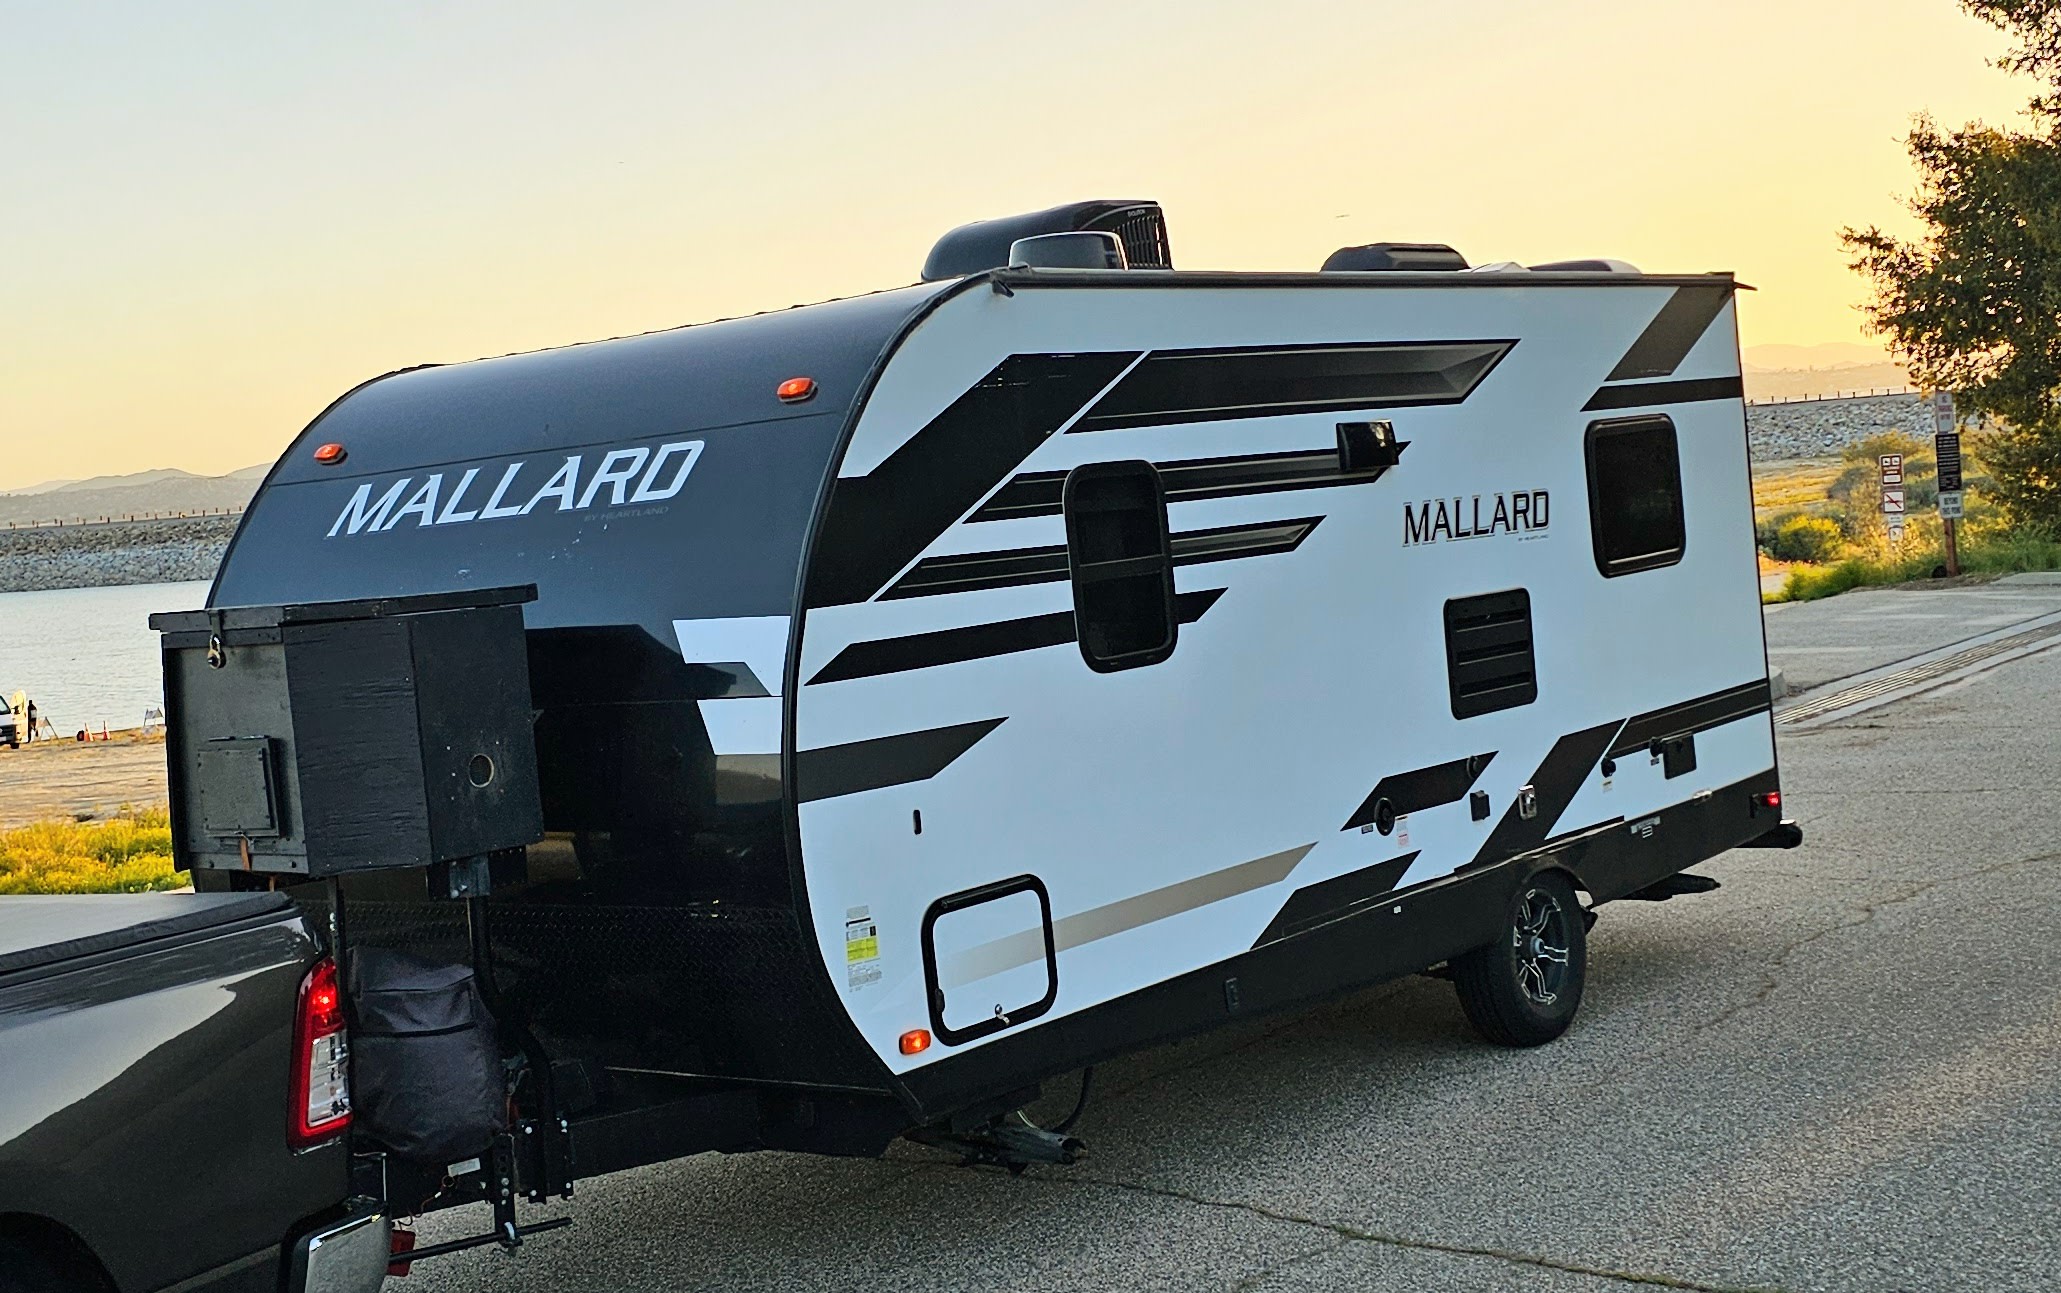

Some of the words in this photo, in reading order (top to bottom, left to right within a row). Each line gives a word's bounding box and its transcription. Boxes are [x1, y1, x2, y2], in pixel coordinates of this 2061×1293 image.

[327, 440, 705, 537] MALLARD
[601, 507, 669, 521] HEARTLAND
[1402, 488, 1549, 547] MALLARD
